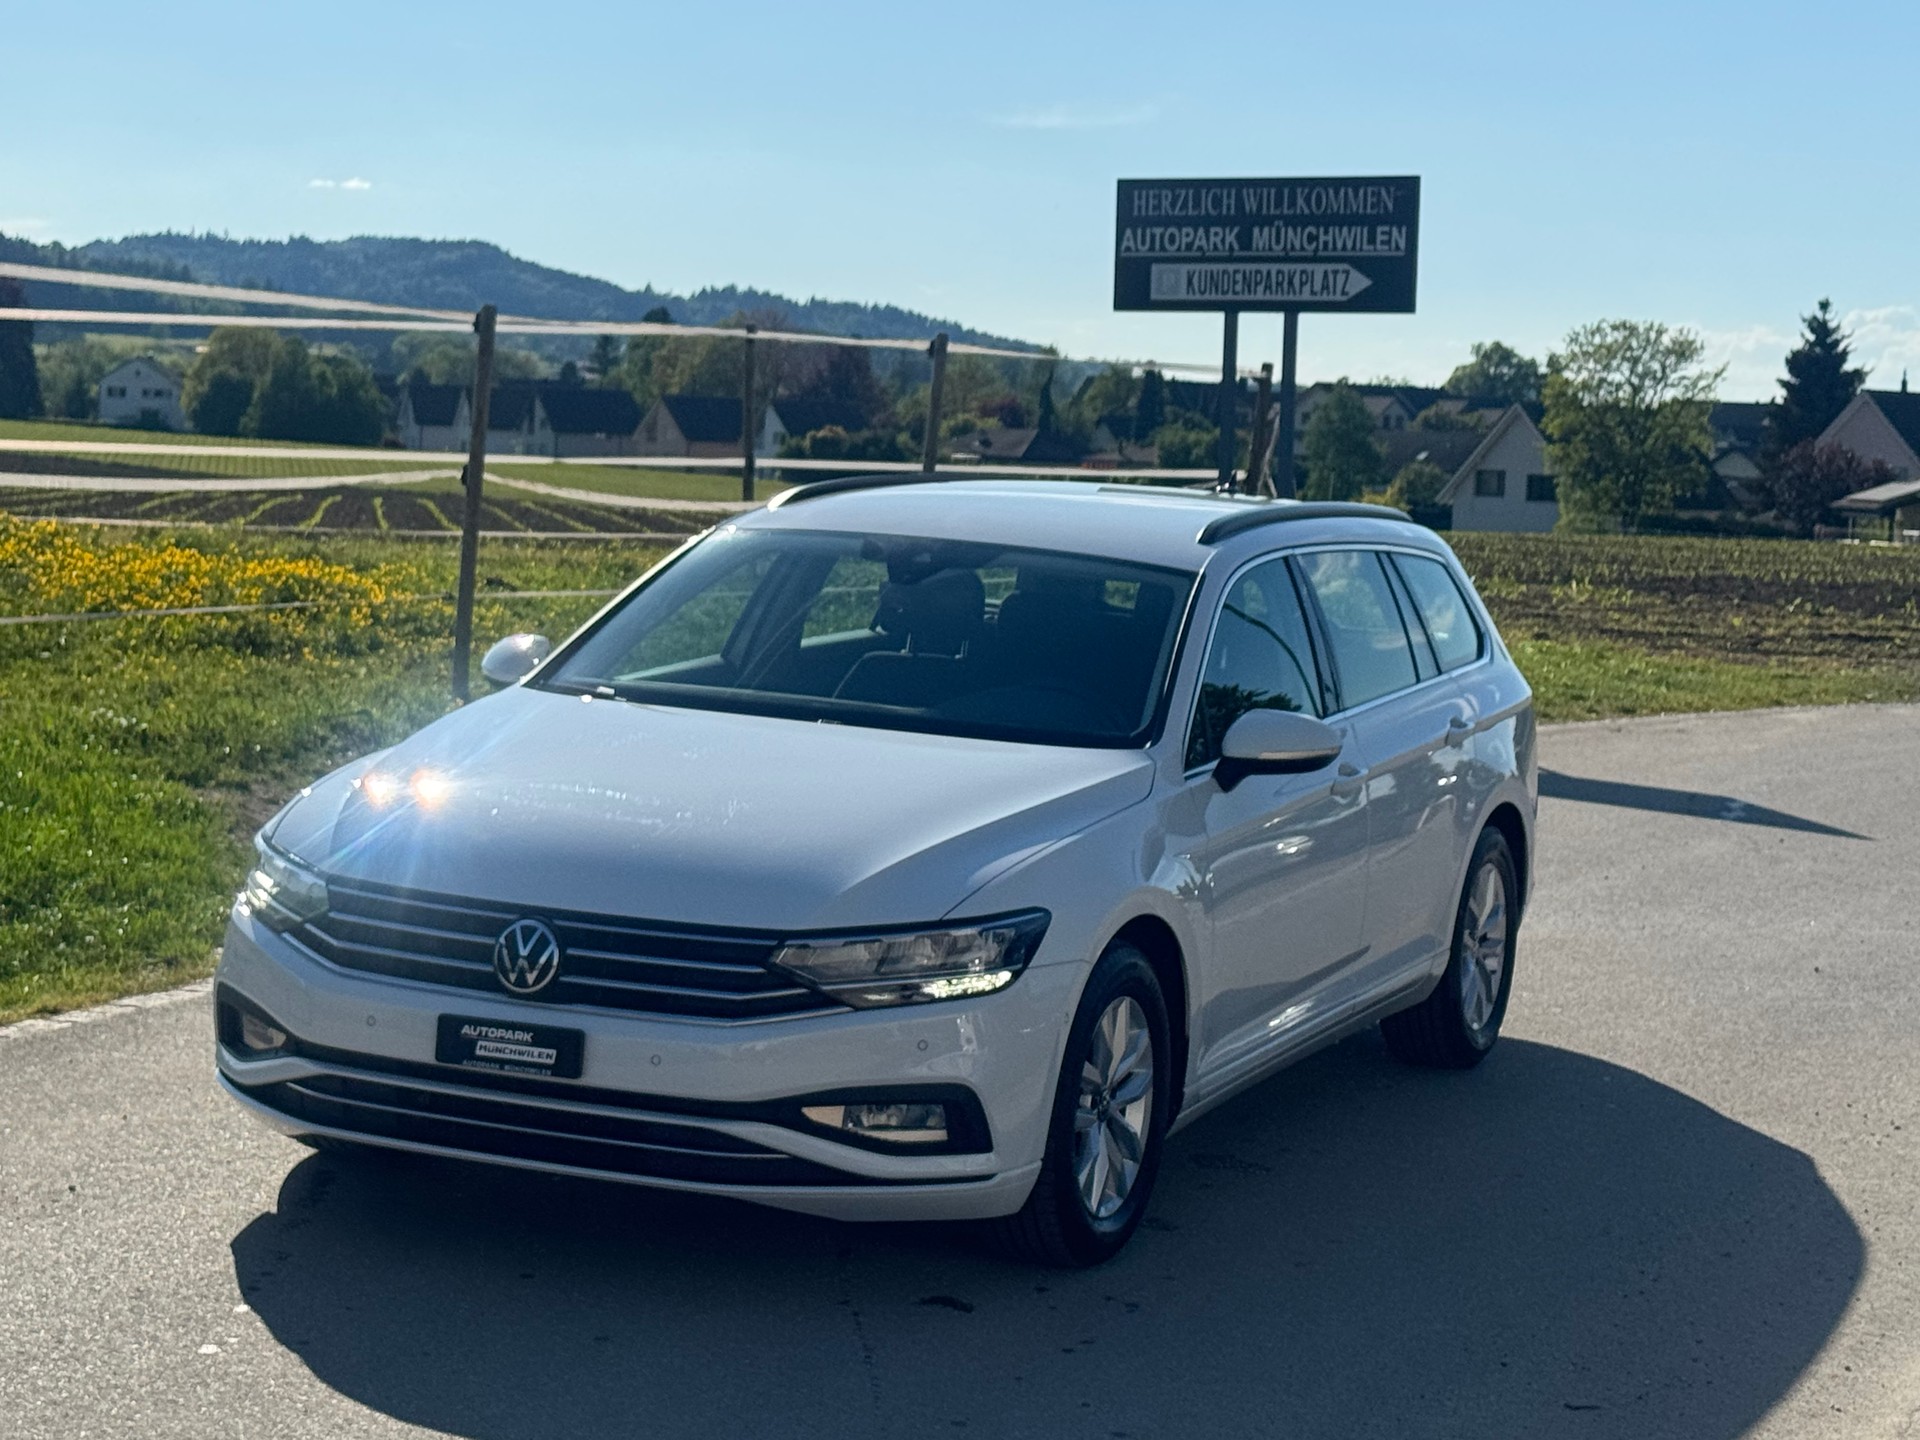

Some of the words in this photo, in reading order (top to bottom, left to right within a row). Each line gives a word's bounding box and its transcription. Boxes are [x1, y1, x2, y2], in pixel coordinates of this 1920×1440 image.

[1133, 187, 1236, 216] HERZLICH
[1243, 185, 1396, 214] WILLKOMMEN
[1121, 226, 1240, 251] AUTOPARK
[1252, 221, 1408, 251] MÜNCHWILEN
[1186, 269, 1351, 297] KUNDENPARKPLATZ
[461, 1024, 533, 1042] AUTOPARK
